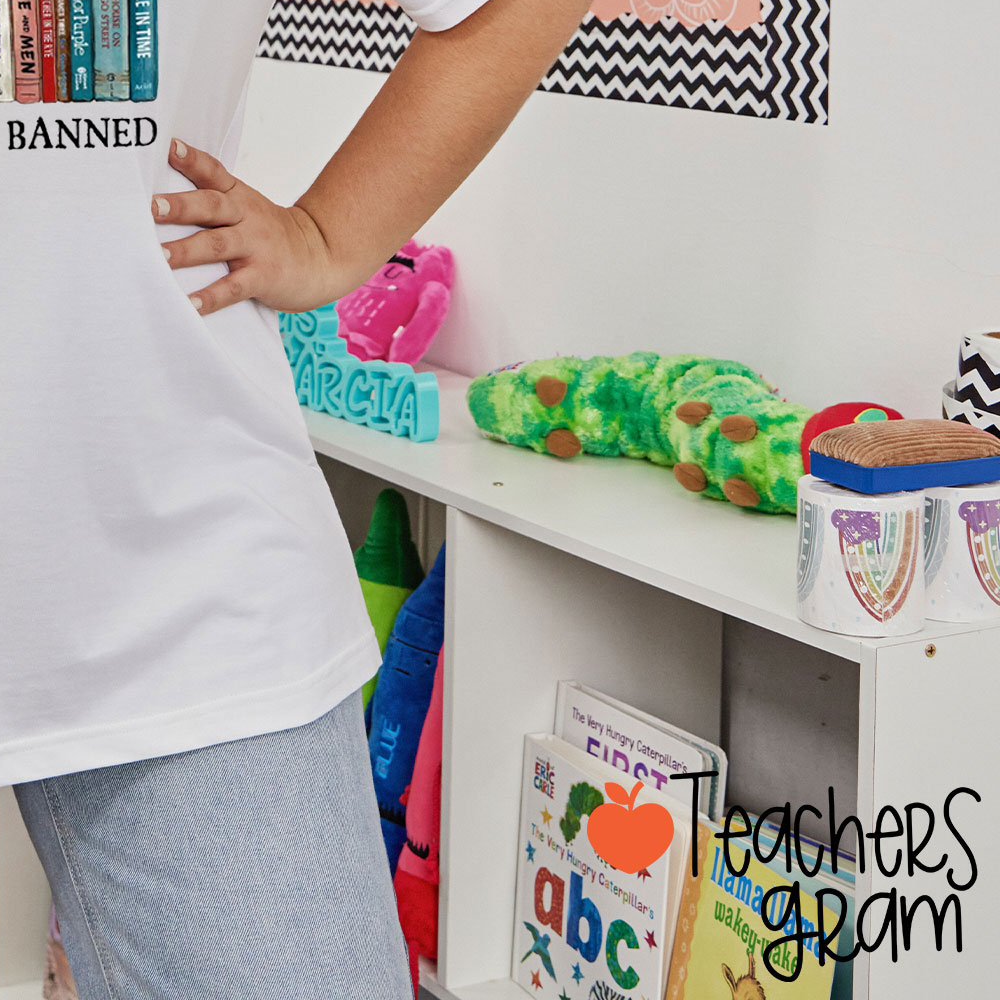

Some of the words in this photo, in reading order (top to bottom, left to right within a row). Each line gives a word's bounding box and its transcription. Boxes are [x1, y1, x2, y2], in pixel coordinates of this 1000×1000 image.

[43, 29, 53, 43] THE
[71, 15, 90, 56] Purple
[101, 14, 110, 49] STREET
[135, 11, 151, 26] IN
[20, 34, 36, 74] MEN
[112, 31, 121, 47] ON
[135, 27, 152, 59] TIME
[7, 116, 159, 150] BANNED
[284, 352, 418, 437] ARCIA
[374, 718, 402, 779] BLUE
[572, 706, 586, 725] The
[587, 713, 605, 735] Very
[605, 724, 635, 750] Hungry
[636, 740, 689, 775] Caterpillar's
[533, 775, 555, 800] CARLE
[535, 761, 556, 786] ERIC
[531, 822, 545, 843] The
[547, 834, 566, 861] Very
[566, 848, 597, 883] Hungry
[598, 872, 655, 921] Caterpillar's
[710, 845, 764, 917] llama
[534, 866, 641, 991] abc
